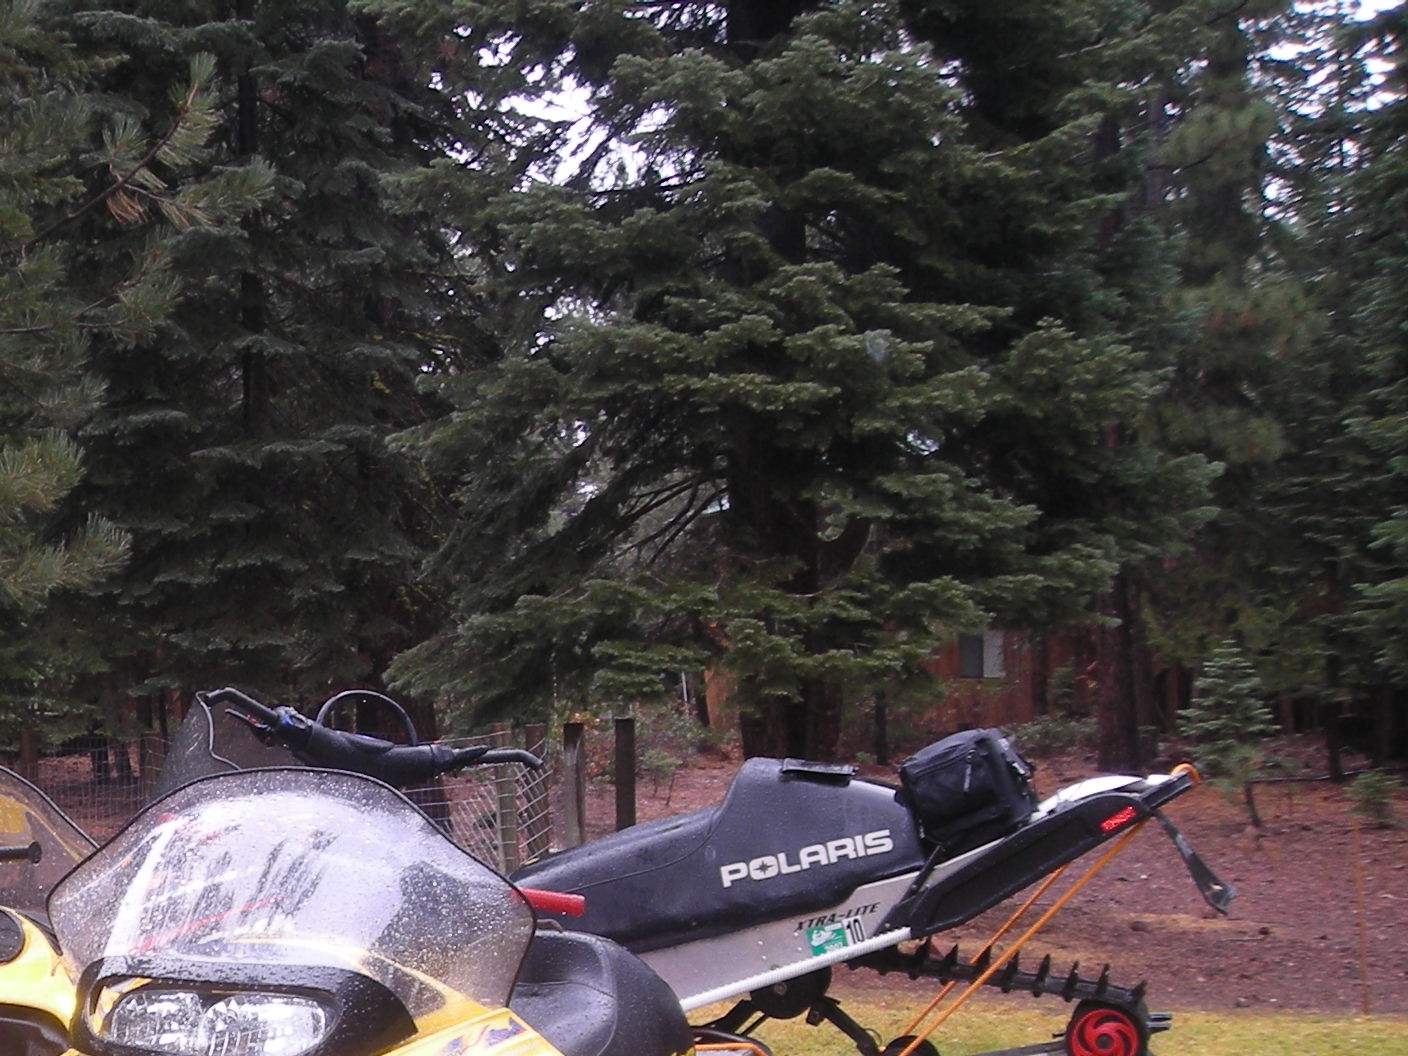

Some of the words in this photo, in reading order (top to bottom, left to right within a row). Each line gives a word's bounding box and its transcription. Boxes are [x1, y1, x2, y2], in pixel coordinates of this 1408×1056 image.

[720, 829, 893, 888] POLARIS
[794, 902, 880, 932] XTRA-LITE
[846, 918, 865, 944] 10
